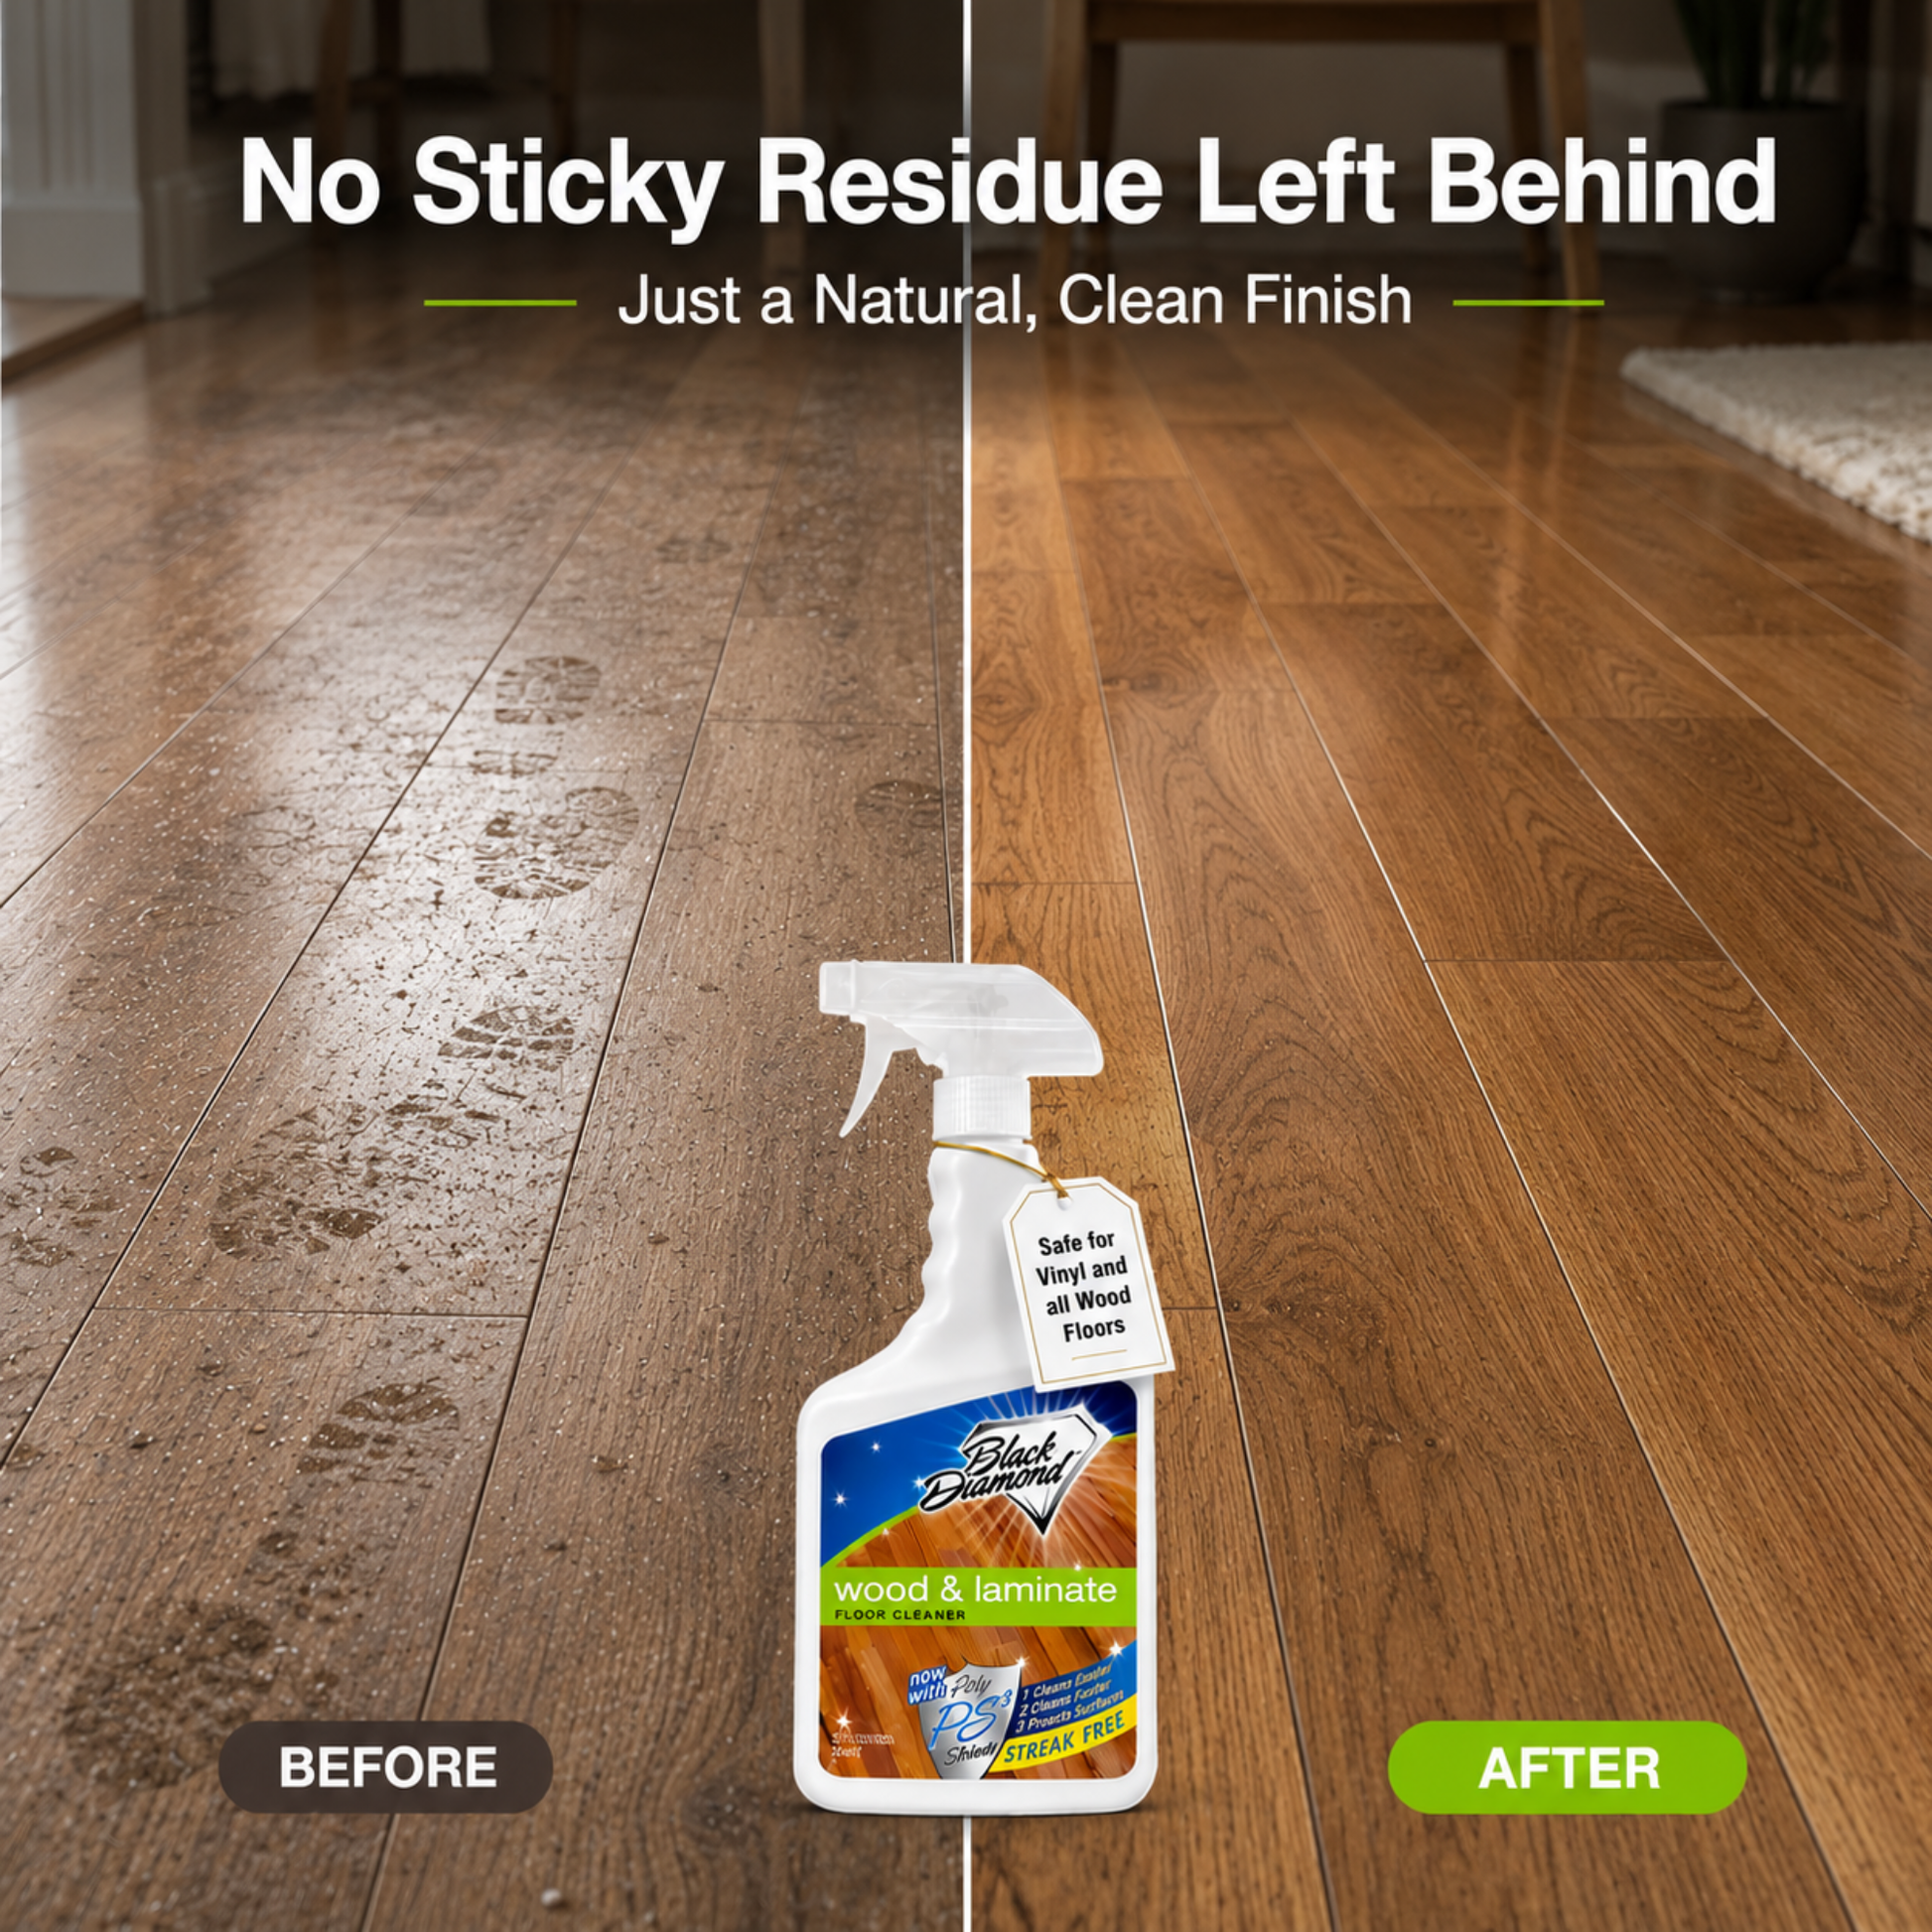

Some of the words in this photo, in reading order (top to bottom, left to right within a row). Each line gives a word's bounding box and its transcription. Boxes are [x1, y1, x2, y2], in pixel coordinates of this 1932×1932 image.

[1038, 1234, 1082, 1256] Safe
[1087, 1231, 1115, 1249] for
[1035, 1262, 1086, 1287] Vinyl
[1092, 1255, 1128, 1278] and
[1046, 1295, 1070, 1315] all
[1075, 1285, 1131, 1311] Wood
[1063, 1318, 1126, 1342] Floors
[962, 1431, 1056, 1475] Black
[919, 1450, 1074, 1512] Diamond
[834, 1576, 928, 1602] wood
[940, 1576, 964, 1602] &
[975, 1576, 1118, 1602] laminate
[834, 1609, 887, 1620] FLOOR
[893, 1609, 966, 1620] CLEANER
[909, 1666, 946, 1687] now
[950, 1675, 993, 1699] Poly
[908, 1682, 946, 1704] with
[1004, 1730, 1074, 1763] STREAK
[1082, 1710, 1125, 1743] FREE
